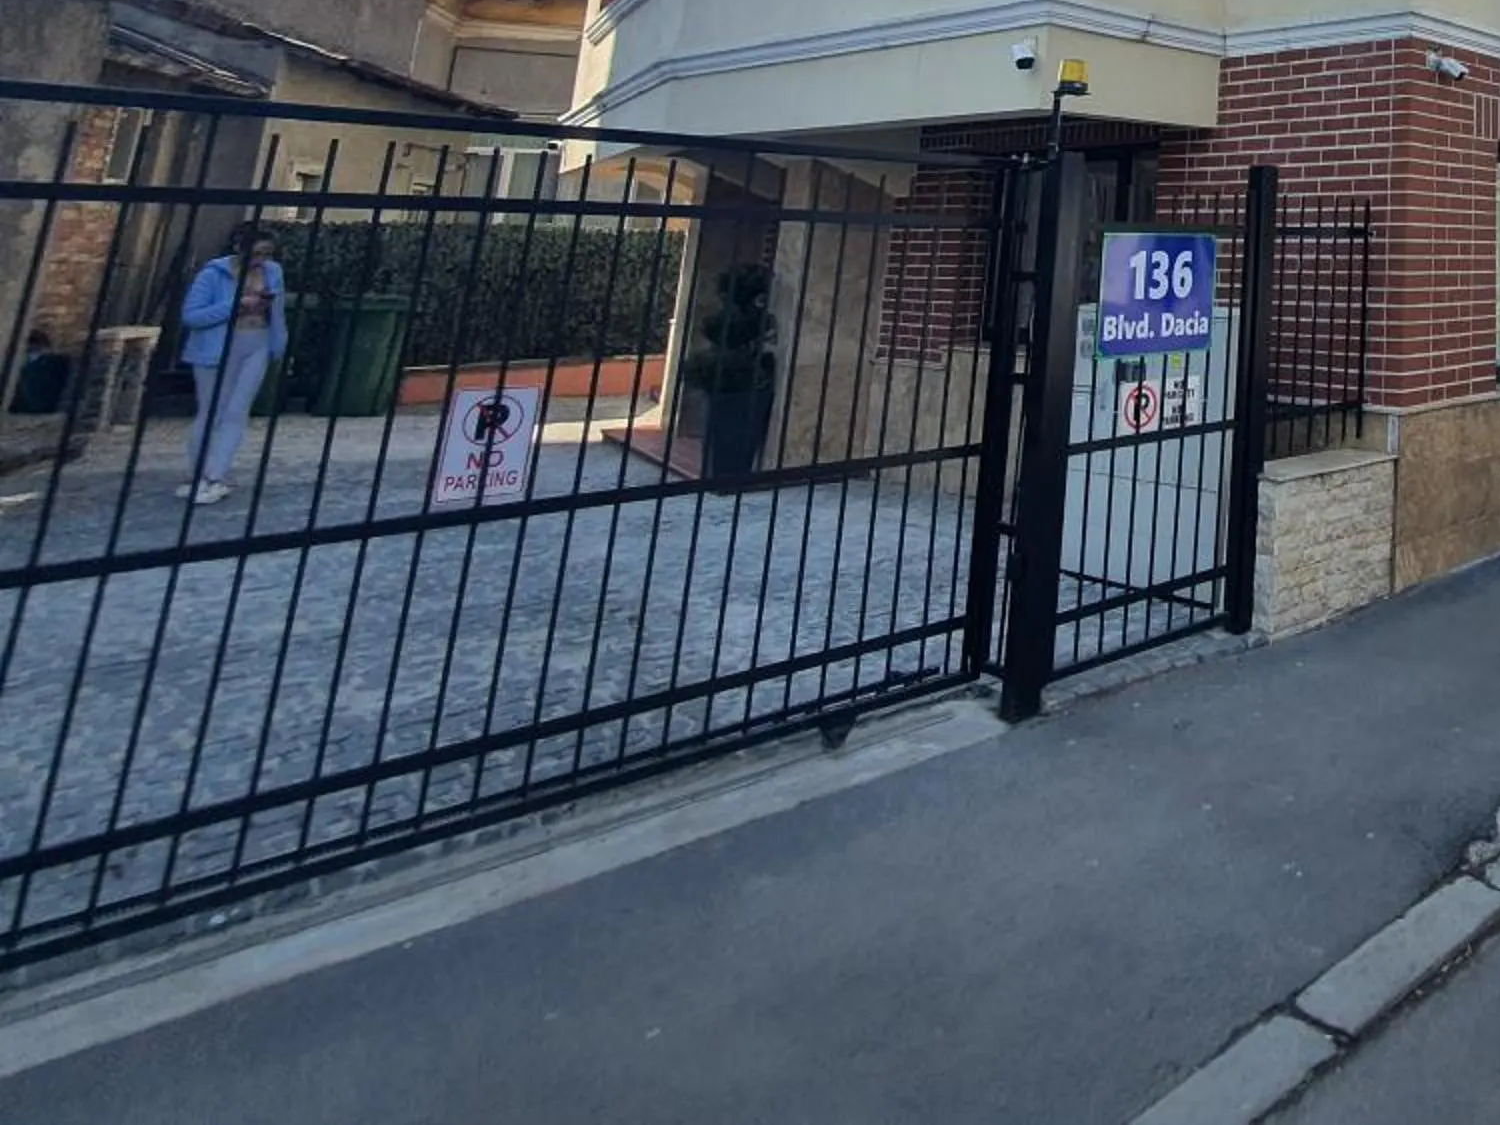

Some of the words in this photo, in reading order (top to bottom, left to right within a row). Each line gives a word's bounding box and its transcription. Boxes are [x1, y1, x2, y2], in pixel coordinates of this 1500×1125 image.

[1130, 249, 1193, 300] 136
[1103, 312, 1154, 342] Blvd.
[1161, 310, 1209, 338] Dacia
[466, 450, 504, 470] NO
